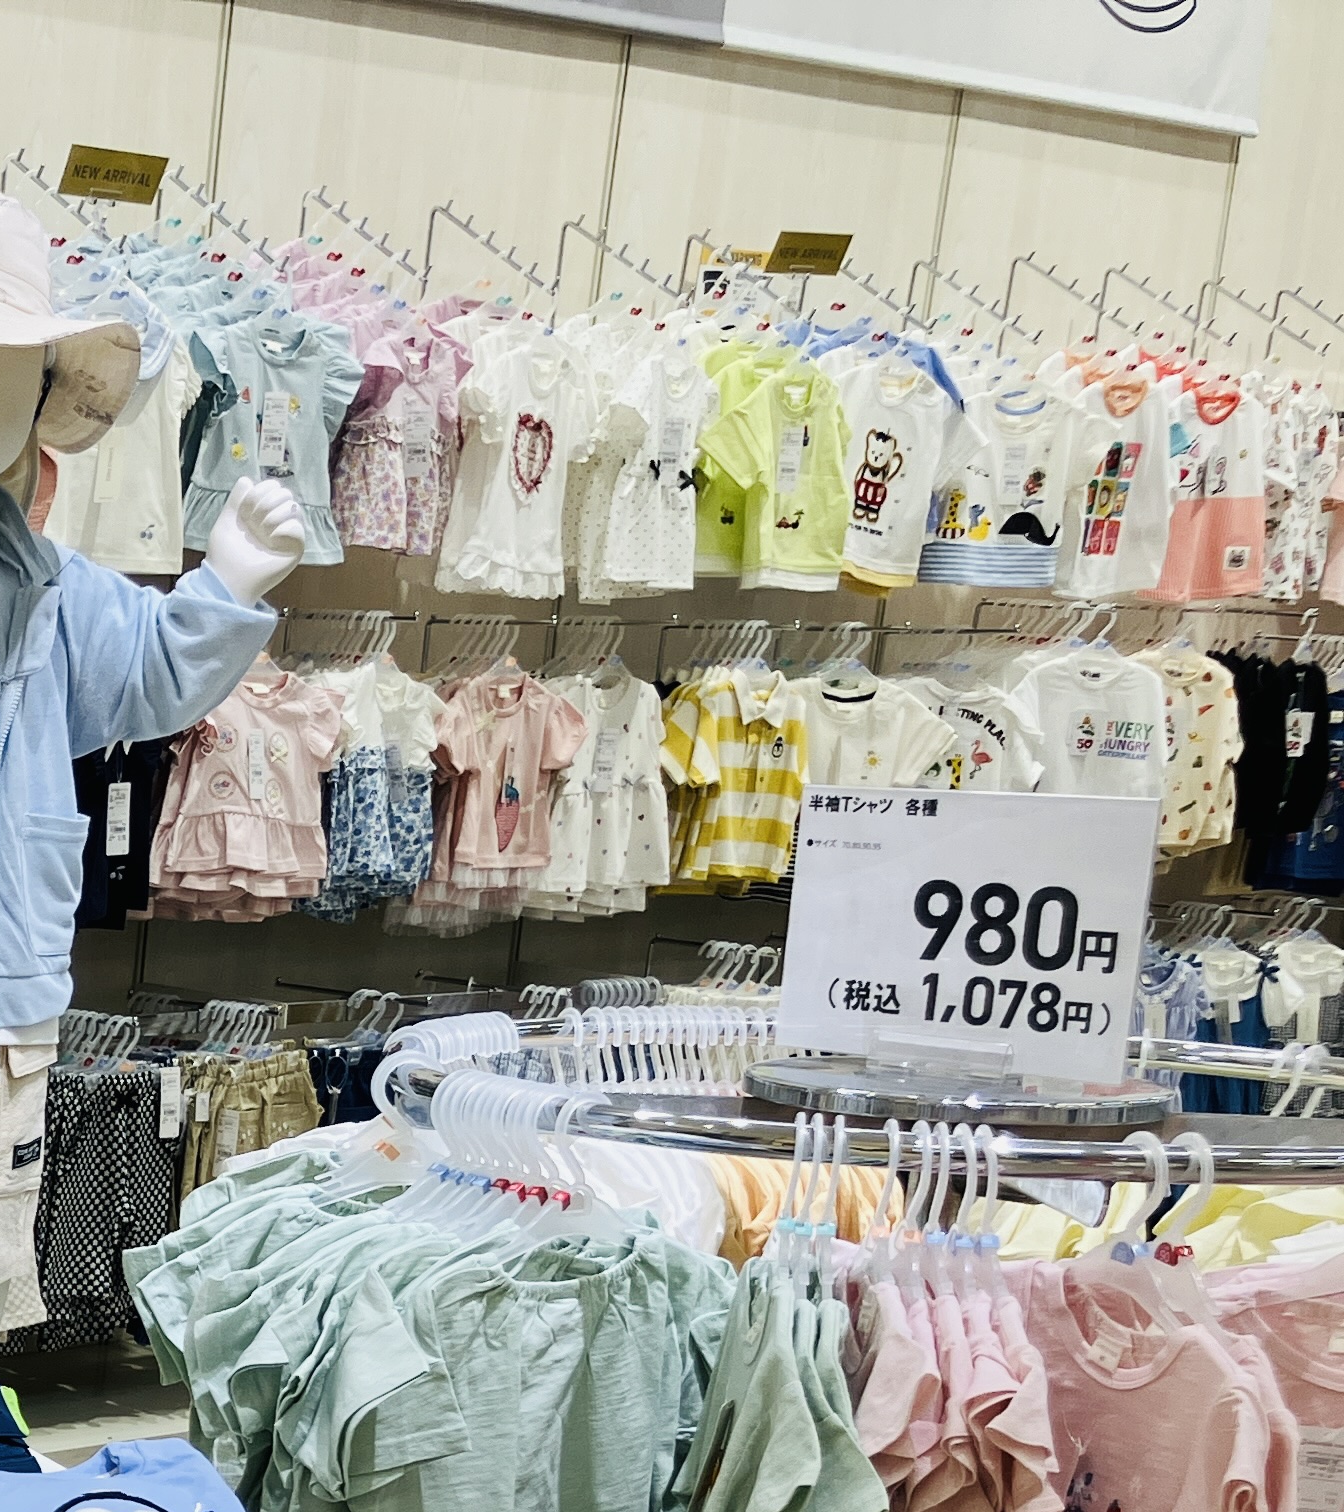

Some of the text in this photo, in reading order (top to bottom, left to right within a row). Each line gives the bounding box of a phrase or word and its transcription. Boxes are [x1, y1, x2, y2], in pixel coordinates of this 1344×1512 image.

[72, 164, 151, 188] NEW ARRIVAL
[1114, 720, 1154, 740] VERY
[808, 794, 939, 816] 半袖Tシャツ 各種
[914, 879, 1119, 974] 980円
